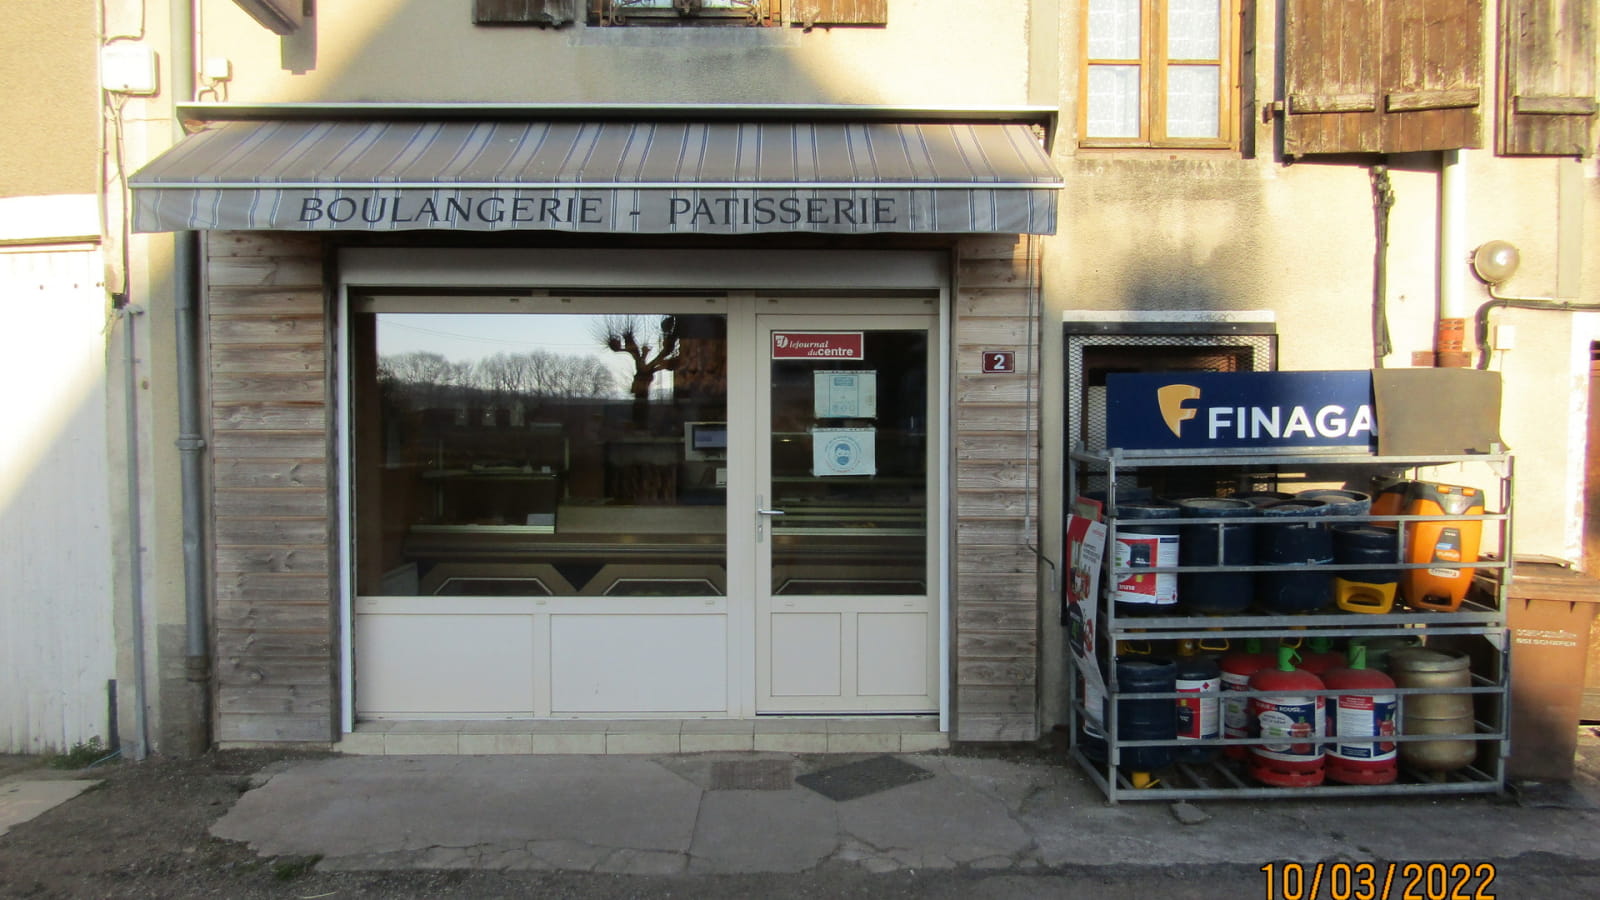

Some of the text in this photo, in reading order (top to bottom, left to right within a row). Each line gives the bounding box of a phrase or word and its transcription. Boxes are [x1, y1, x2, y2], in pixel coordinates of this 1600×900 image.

[298, 196, 603, 223] BOULANGERIE
[669, 197, 898, 225] PATISSERIE
[993, 354, 1005, 370] 2
